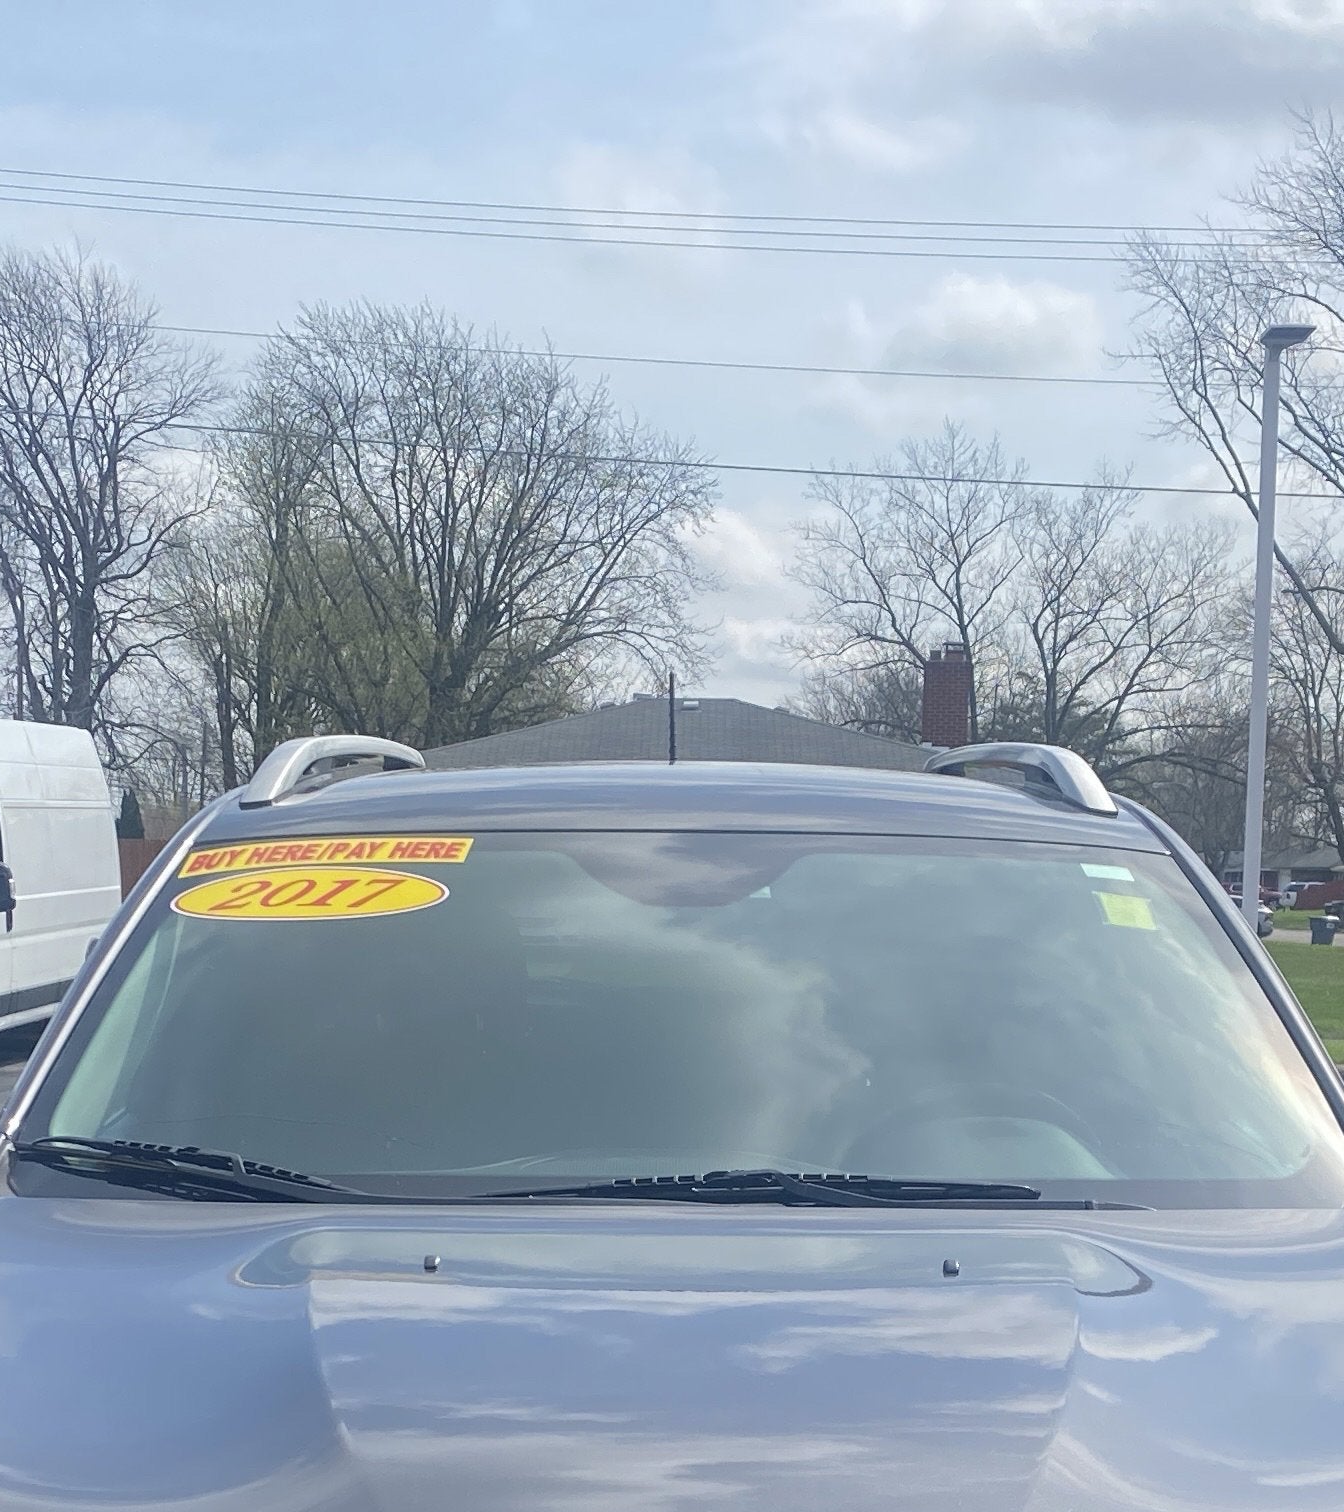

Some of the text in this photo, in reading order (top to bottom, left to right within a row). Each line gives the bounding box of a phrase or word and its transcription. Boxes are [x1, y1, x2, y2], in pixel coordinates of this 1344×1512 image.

[187, 840, 468, 873] BUY HERE/PAY HERE
[207, 879, 407, 911] 2017
